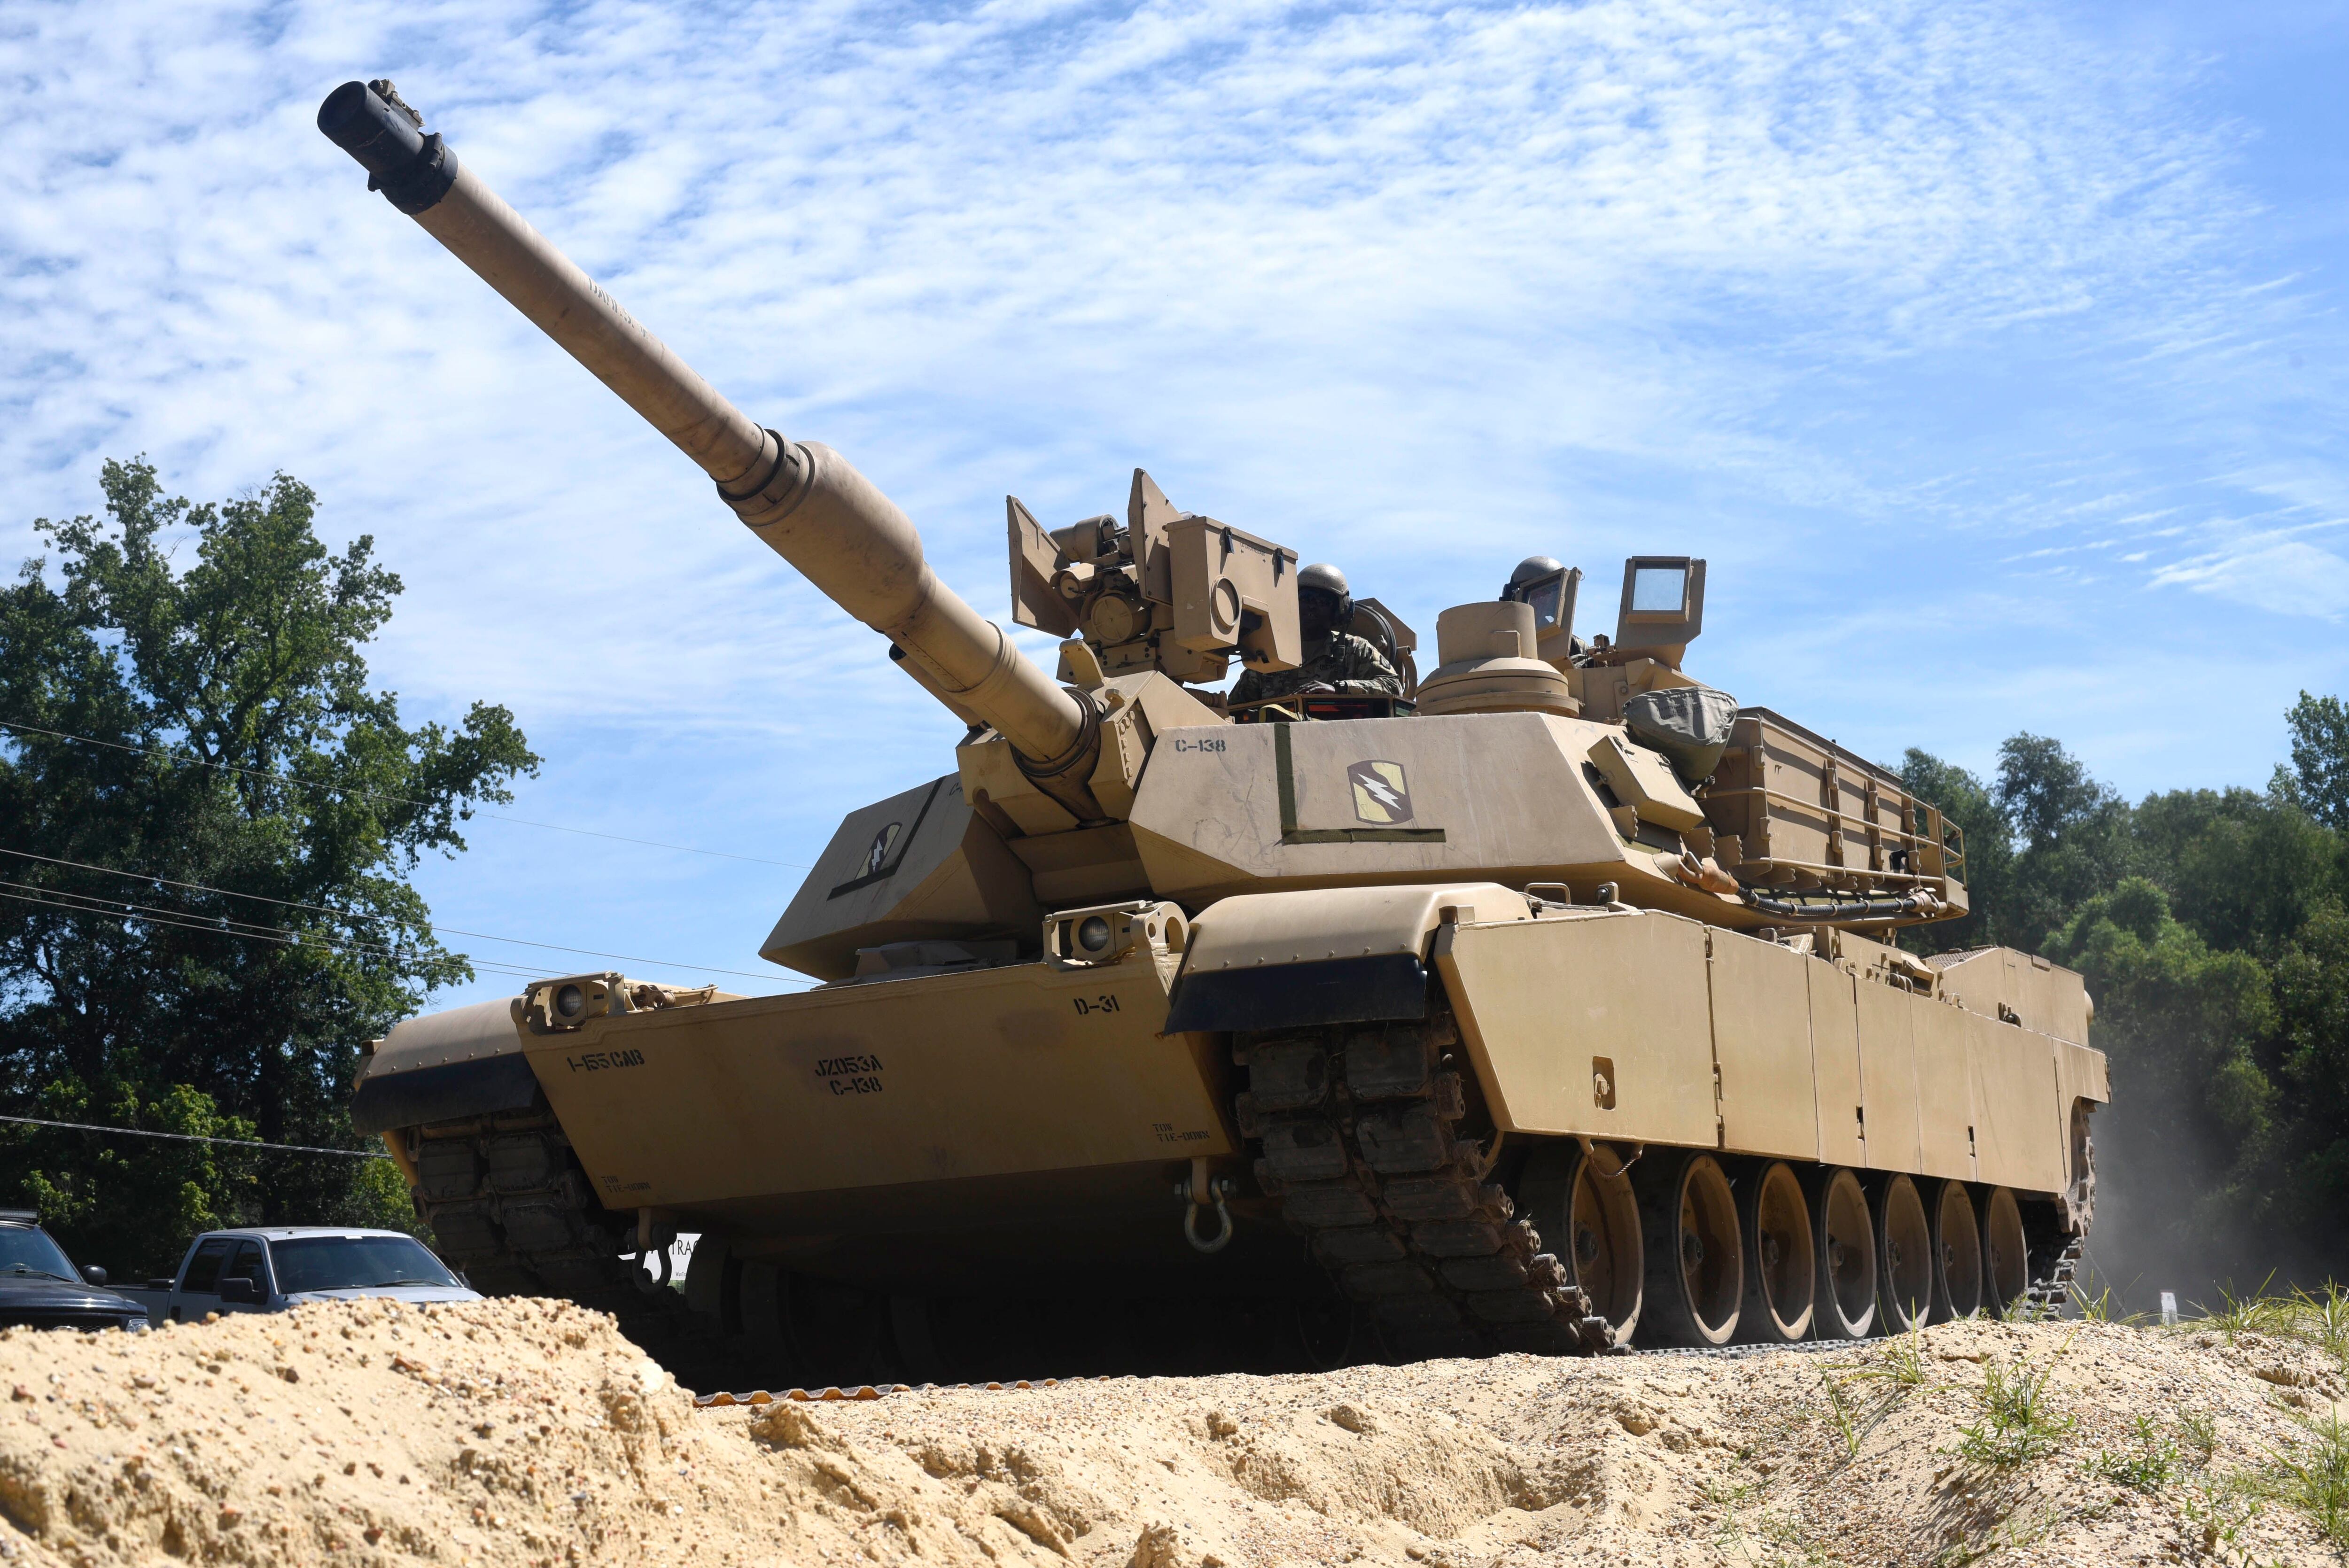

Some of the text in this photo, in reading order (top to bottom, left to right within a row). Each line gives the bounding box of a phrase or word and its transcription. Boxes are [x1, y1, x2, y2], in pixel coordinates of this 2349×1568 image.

[1175, 739, 1226, 752] C-138
[1073, 994, 1120, 1015] D-31
[567, 1049, 645, 1072] 1-155 CAB
[814, 1054, 884, 1077] JZ053A
[829, 1076, 883, 1096] C-138
[1152, 1123, 1173, 1133] TOW
[1156, 1130, 1211, 1142] TIE-DOWN
[601, 1175, 619, 1184] TOW
[606, 1181, 651, 1193] TIE-DOWN
